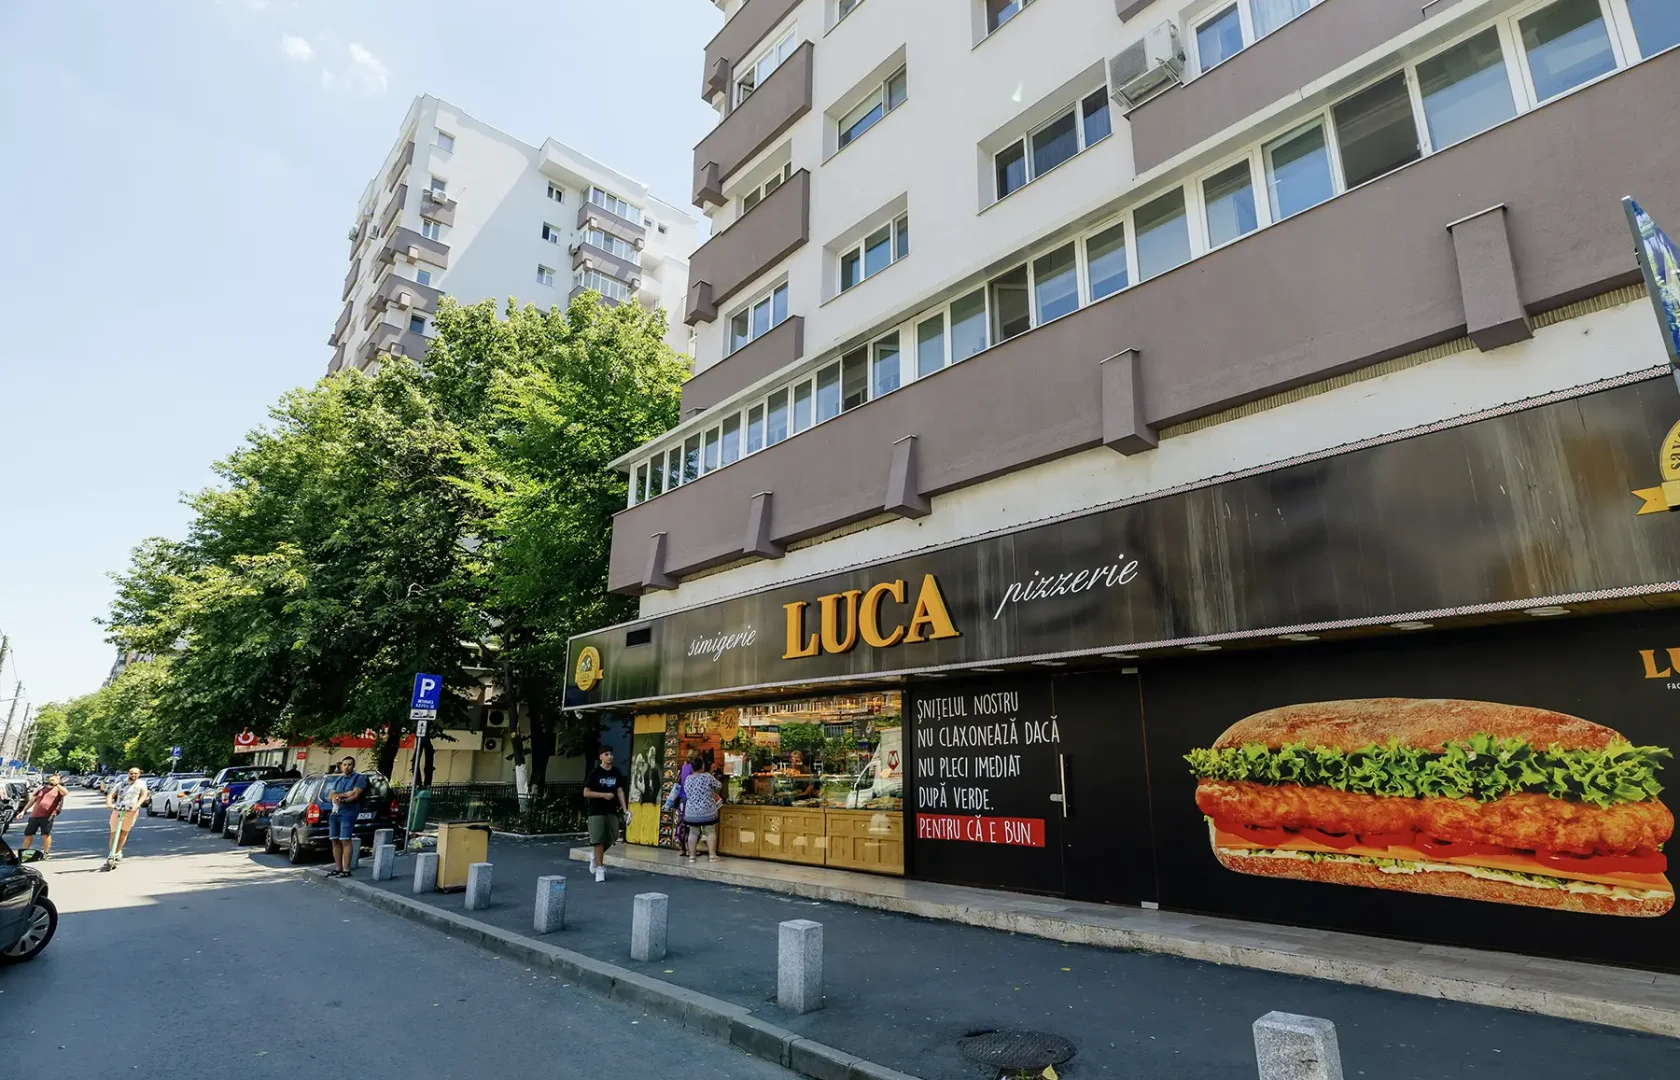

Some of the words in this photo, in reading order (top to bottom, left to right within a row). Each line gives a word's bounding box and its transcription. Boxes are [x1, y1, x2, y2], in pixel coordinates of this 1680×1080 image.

[687, 625, 756, 662] simigerie
[782, 573, 960, 660] LUCA
[993, 553, 1139, 620] pizzerie
[419, 678, 436, 698] P
[974, 691, 1019, 716] NOSTRU
[917, 727, 934, 748] NU
[939, 717, 1019, 748] CLAXONEAZĂ
[1024, 714, 1061, 745] DACĂ
[918, 757, 934, 778] NU
[940, 757, 968, 778] PLECI
[975, 754, 1021, 778] IMEDIAT
[918, 781, 948, 809] DUPĂ
[953, 787, 994, 810] VERDE.
[919, 817, 960, 840] PENTRU
[966, 814, 983, 842] CĂ
[989, 821, 997, 843] E
[1004, 820, 1036, 845] BUN.
